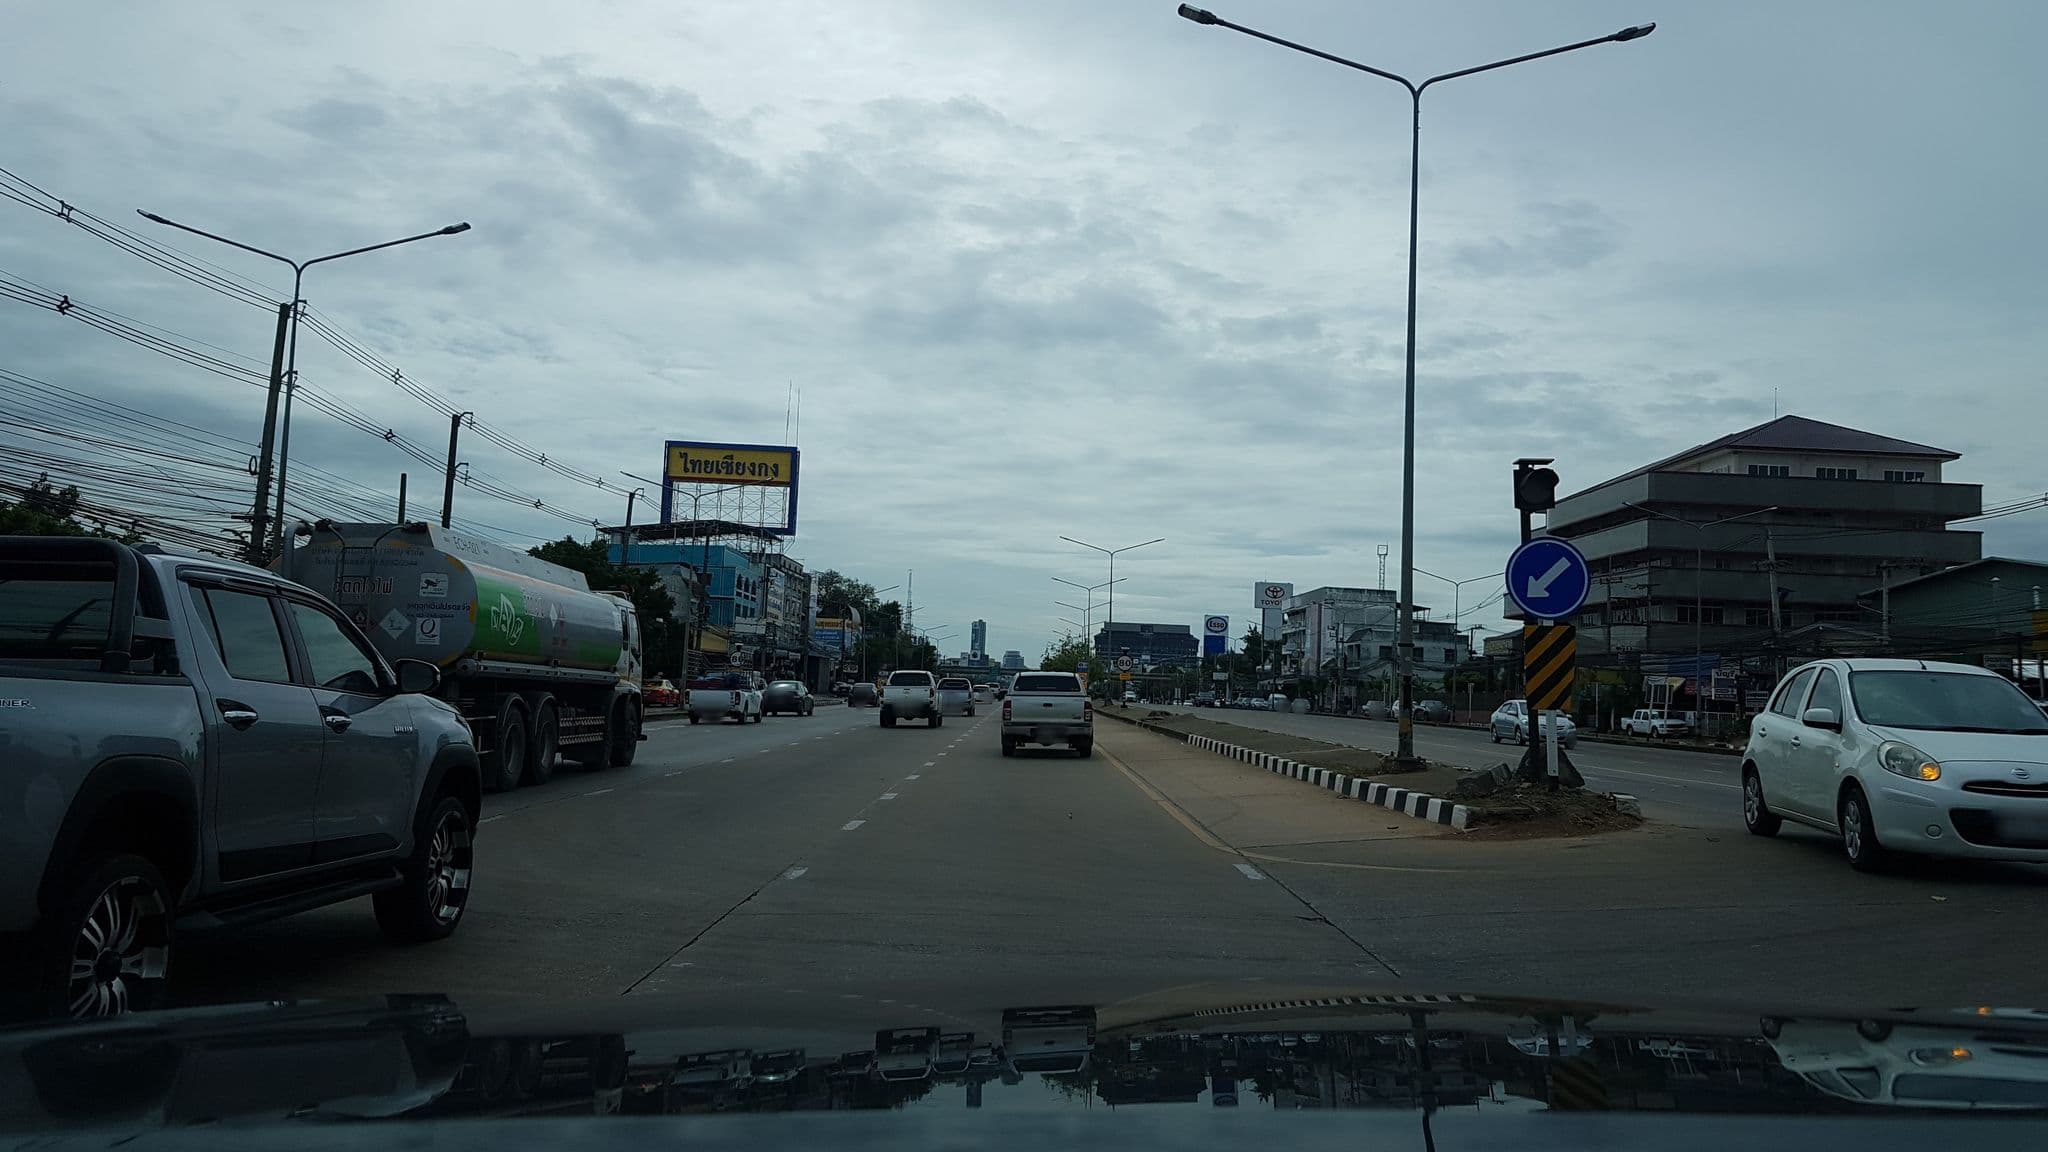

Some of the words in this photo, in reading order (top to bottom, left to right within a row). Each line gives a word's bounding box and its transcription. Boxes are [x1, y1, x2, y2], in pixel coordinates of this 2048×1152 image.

[679, 451, 779, 478] ไทยเซียงกง
[1209, 620, 1225, 628] Esso
[1119, 659, 1131, 667] 80
[0, 698, 31, 709] NER
